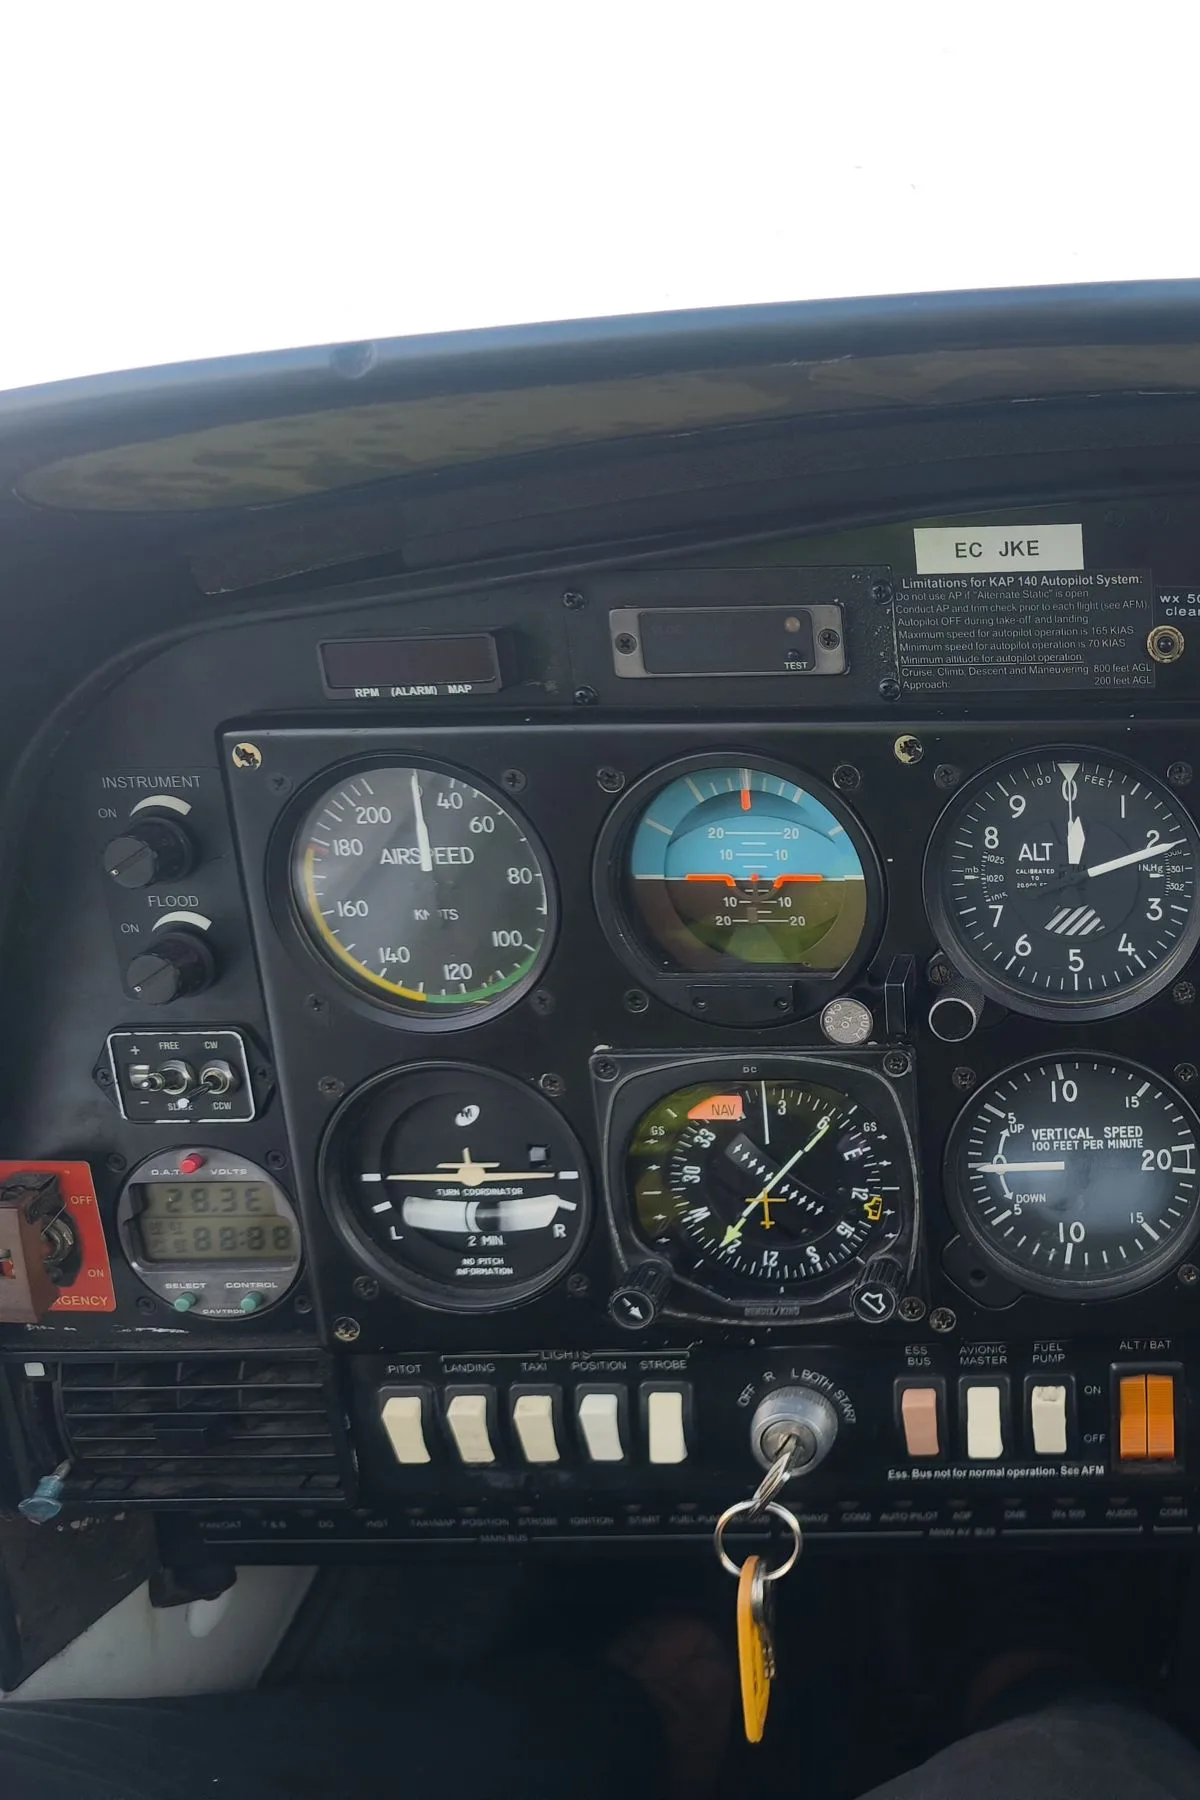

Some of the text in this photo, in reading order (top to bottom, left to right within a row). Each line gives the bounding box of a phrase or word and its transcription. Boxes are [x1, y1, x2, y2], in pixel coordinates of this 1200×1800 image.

[954, 540, 1040, 558] EC JKE
[902, 574, 1143, 589] Limitations for KAP 140 Autopilot System:
[1160, 594, 1182, 603] wx
[900, 626, 1133, 640] Maximum speed for autopilot operation is 165 KIAS
[783, 661, 807, 670] TEST
[1094, 676, 1110, 685] 200
[1112, 676, 1130, 685] feet
[1132, 676, 1152, 685] AGL
[355, 684, 472, 698] RPM (ALARM) MAP
[102, 776, 200, 789] INSTRUMENT
[437, 793, 463, 809] 40
[98, 808, 117, 818] ON
[356, 807, 391, 824] 200
[984, 826, 999, 848] 8
[332, 839, 363, 856] 180
[1018, 843, 1053, 862] ALT
[986, 874, 1004, 882] 1020
[148, 895, 198, 907] FLOOD
[1146, 898, 1162, 920] 3
[492, 930, 522, 947] 100
[159, 1042, 179, 1050] FREE
[1052, 1080, 1078, 1102] 10
[212, 1102, 231, 1110] CCW
[711, 1104, 735, 1116] NAV
[1032, 1126, 1143, 1140] VERTICAL SPEED
[1032, 1139, 1143, 1151] 100 FEET PER MINUTE
[437, 1188, 460, 1196] TURN
[71, 1196, 92, 1204] OFF
[1016, 1194, 1046, 1203] DOWN
[960, 1345, 1007, 1354] AVIONIC
[1034, 1343, 1062, 1351] FUEL
[1120, 1340, 1171, 1350] ALT BAT
[960, 1355, 1007, 1364] MASTER
[1033, 1354, 1065, 1363] PUMP
[388, 1365, 421, 1373] PITOT
[444, 1362, 495, 1373] LANDING
[521, 1361, 547, 1371] TAXI
[571, 1360, 626, 1370] POSITION
[640, 1360, 687, 1369] STROBE
[912, 1469, 932, 1478] Bus
[934, 1469, 951, 1478] not
[953, 1468, 967, 1477] for
[969, 1467, 1005, 1477] normal
[1007, 1467, 1058, 1478] operation.
[1060, 1466, 1080, 1476] See
[1082, 1465, 1104, 1475] AFM
